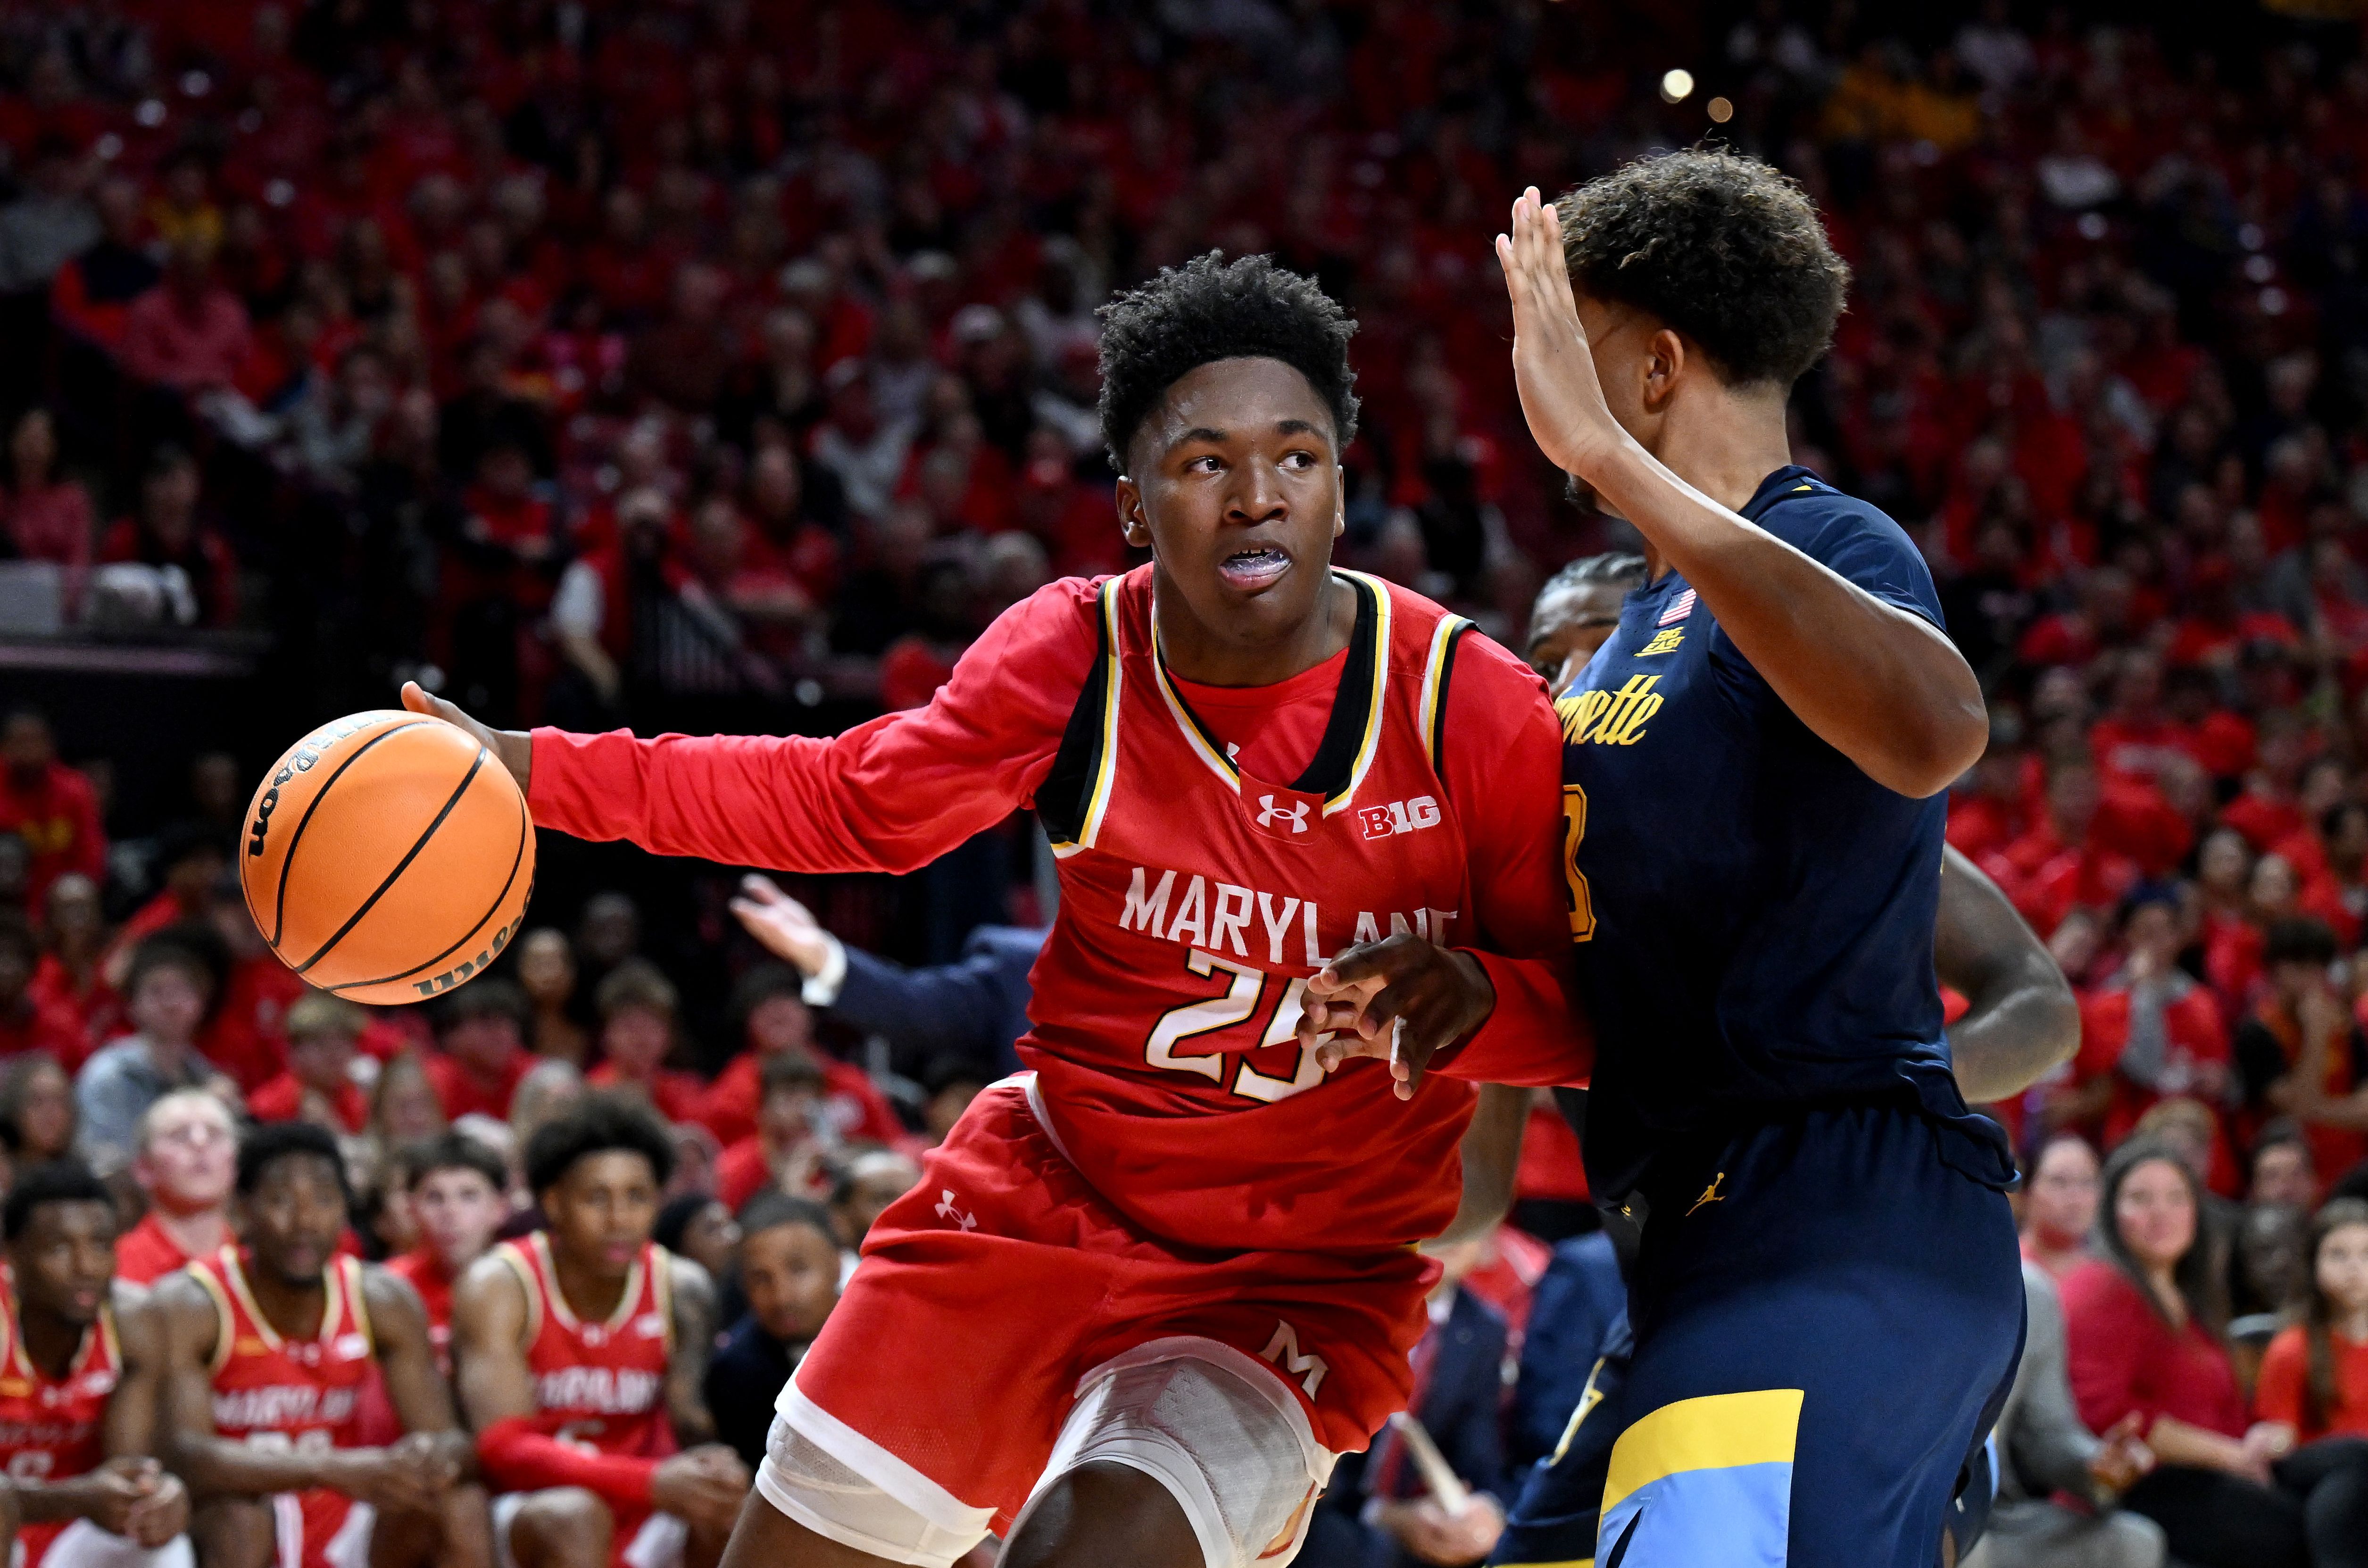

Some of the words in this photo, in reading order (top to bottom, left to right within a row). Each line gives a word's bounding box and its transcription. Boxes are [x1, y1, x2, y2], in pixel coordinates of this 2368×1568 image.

[1641, 636, 1686, 653] EAST
[1653, 626, 1685, 642] BIG
[1145, 948, 1340, 1104] 25
[1258, 1319, 1329, 1402] M
